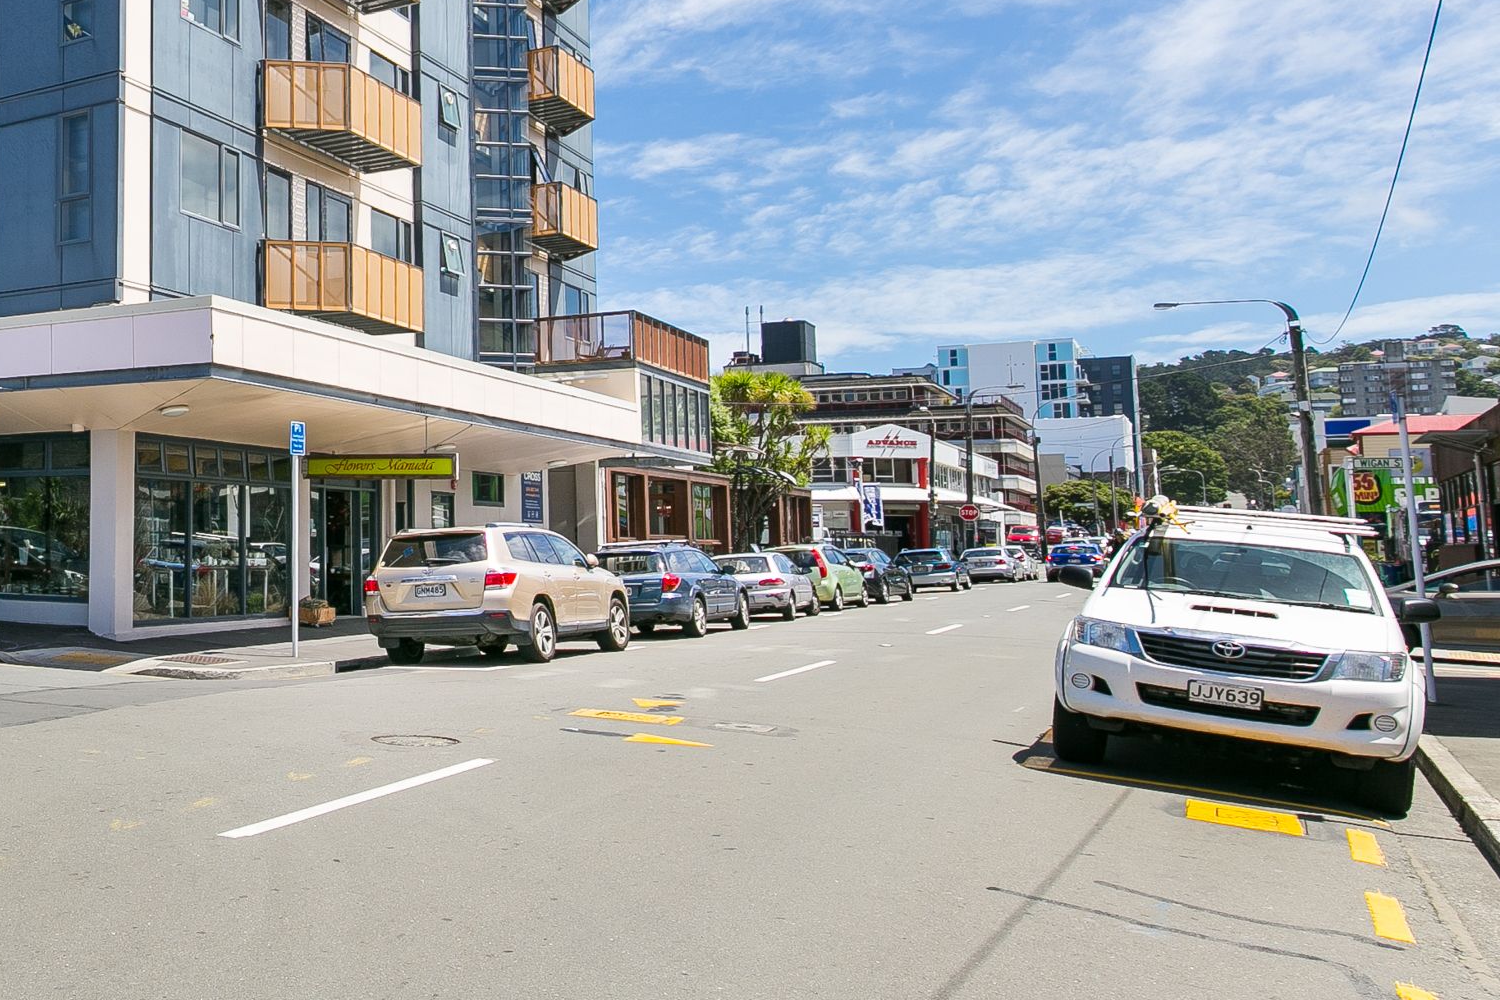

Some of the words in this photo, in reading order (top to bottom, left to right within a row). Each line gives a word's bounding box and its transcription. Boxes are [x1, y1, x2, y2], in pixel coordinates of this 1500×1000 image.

[325, 459, 376, 474] Flowers
[377, 458, 435, 471] Manuela
[1360, 459, 1389, 467] WIGAN
[523, 472, 541, 482] CROSS
[1190, 684, 1260, 705] JJY639
